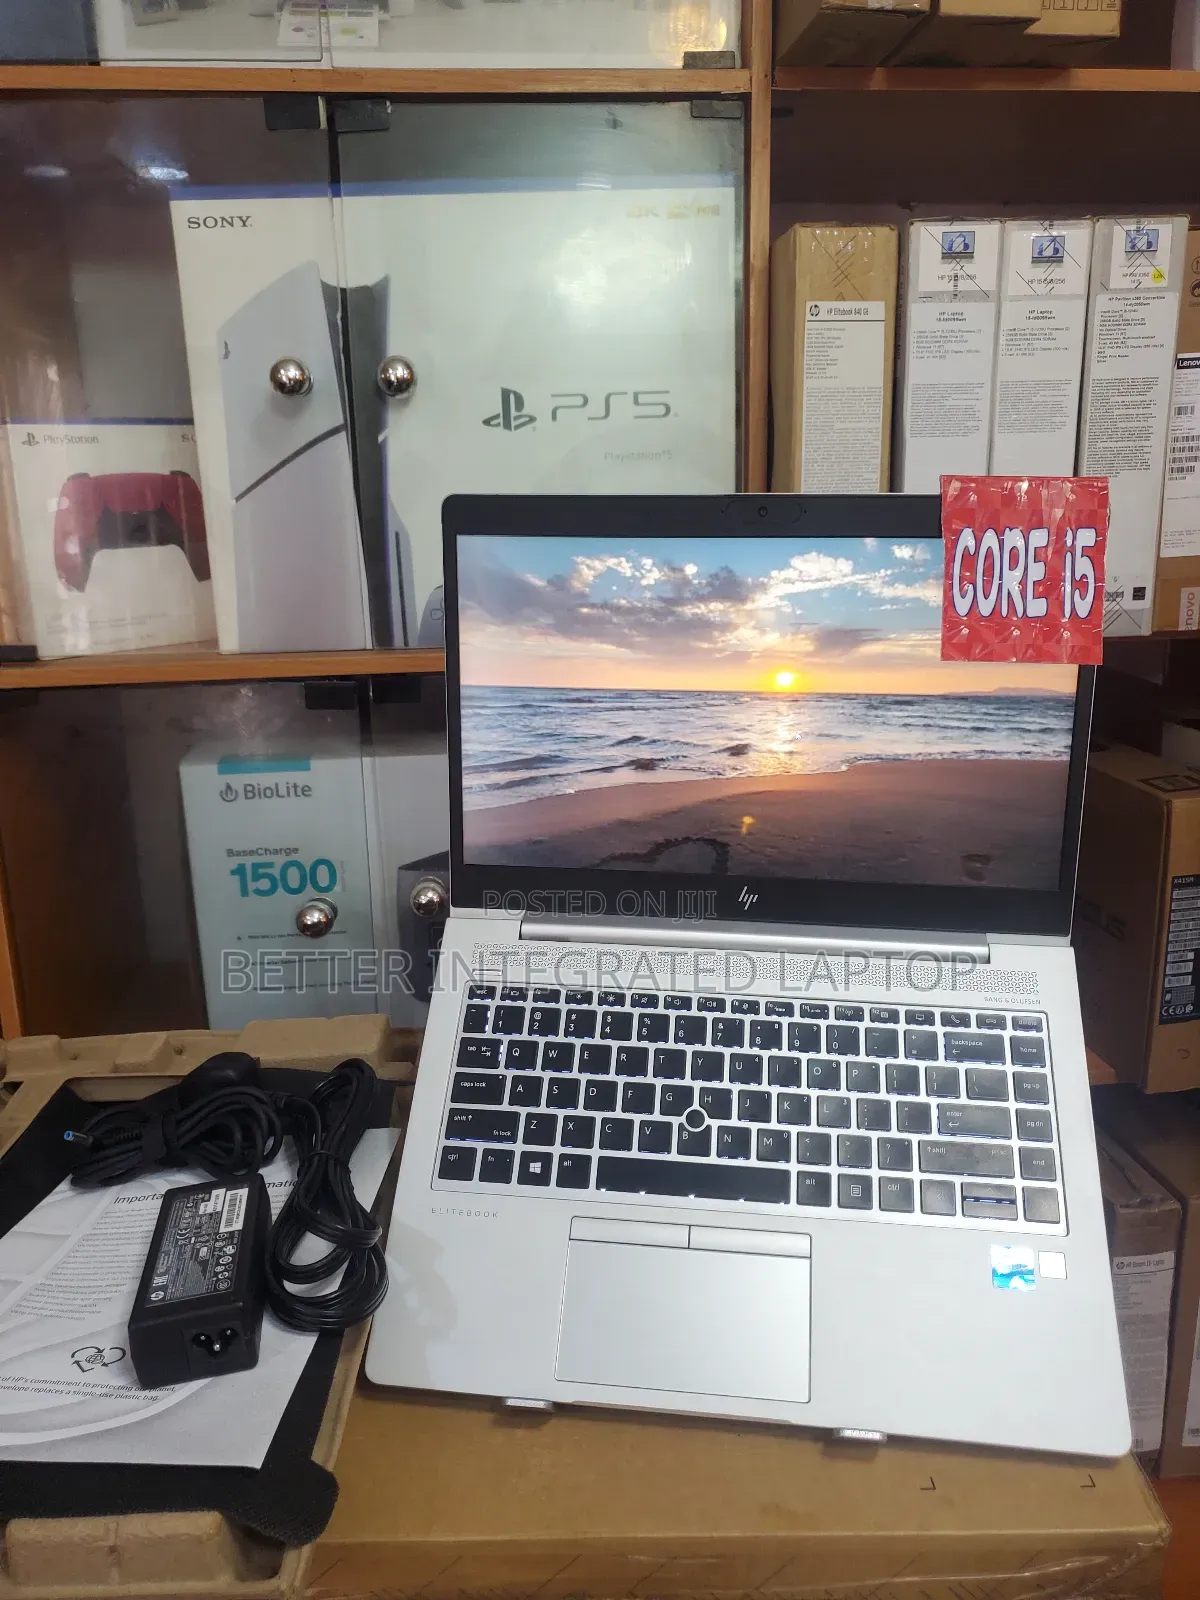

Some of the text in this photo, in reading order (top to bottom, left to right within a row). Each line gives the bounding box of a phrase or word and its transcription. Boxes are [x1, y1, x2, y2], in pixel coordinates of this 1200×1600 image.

[188, 216, 252, 229] SONY
[550, 390, 671, 422] PS5
[44, 434, 100, 445] PlayStation
[952, 526, 1097, 620] CORE i5
[244, 781, 312, 800] BioLite
[226, 846, 299, 858] BaseCharge
[229, 858, 337, 898] 1500
[951, 1039, 983, 1047] backspace
[512, 1048, 520, 1057] Q
[814, 1067, 821, 1075] O
[705, 1095, 711, 1103] H
[784, 1101, 790, 1110] K
[531, 1121, 537, 1129] Z
[568, 1122, 574, 1130] X
[645, 1126, 651, 1135] V
[763, 1138, 773, 1146] M
[114, 1192, 164, 1204] Importa
[432, 1208, 498, 1218] ELITEBOOK
[30, 1378, 81, 1387] commitment
[91, 1382, 133, 1391] protecting
[31, 1386, 64, 1395] replaces
[73, 1390, 114, 1399] single-use
